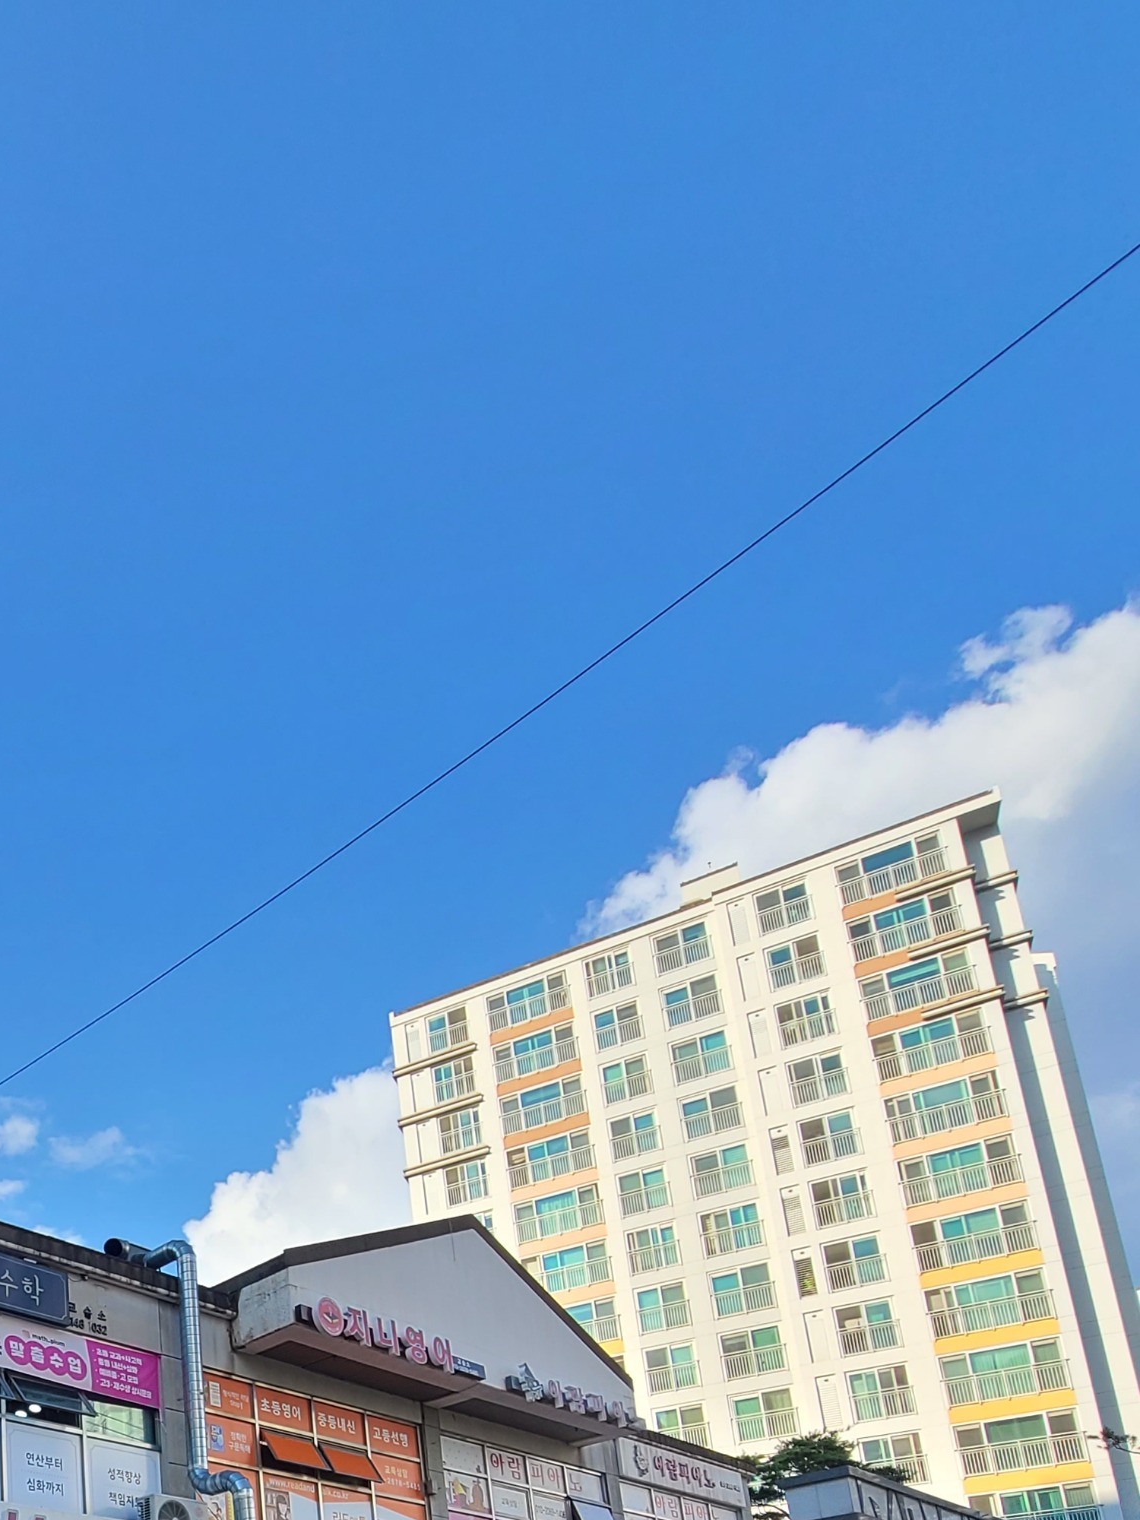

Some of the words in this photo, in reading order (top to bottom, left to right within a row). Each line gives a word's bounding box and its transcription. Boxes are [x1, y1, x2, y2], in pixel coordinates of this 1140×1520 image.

[345, 1305, 456, 1375] 지니영어
[260, 1397, 302, 1421] 초등영어
[547, 1379, 646, 1430] 아람피아
[317, 1411, 356, 1435] 중등내신
[372, 1426, 409, 1448] 고등선행
[25, 1452, 63, 1472] 연산부터
[653, 1455, 716, 1490] 아람피아노
[26, 1478, 64, 1496] 심화까지
[107, 1468, 142, 1485] 성적향상
